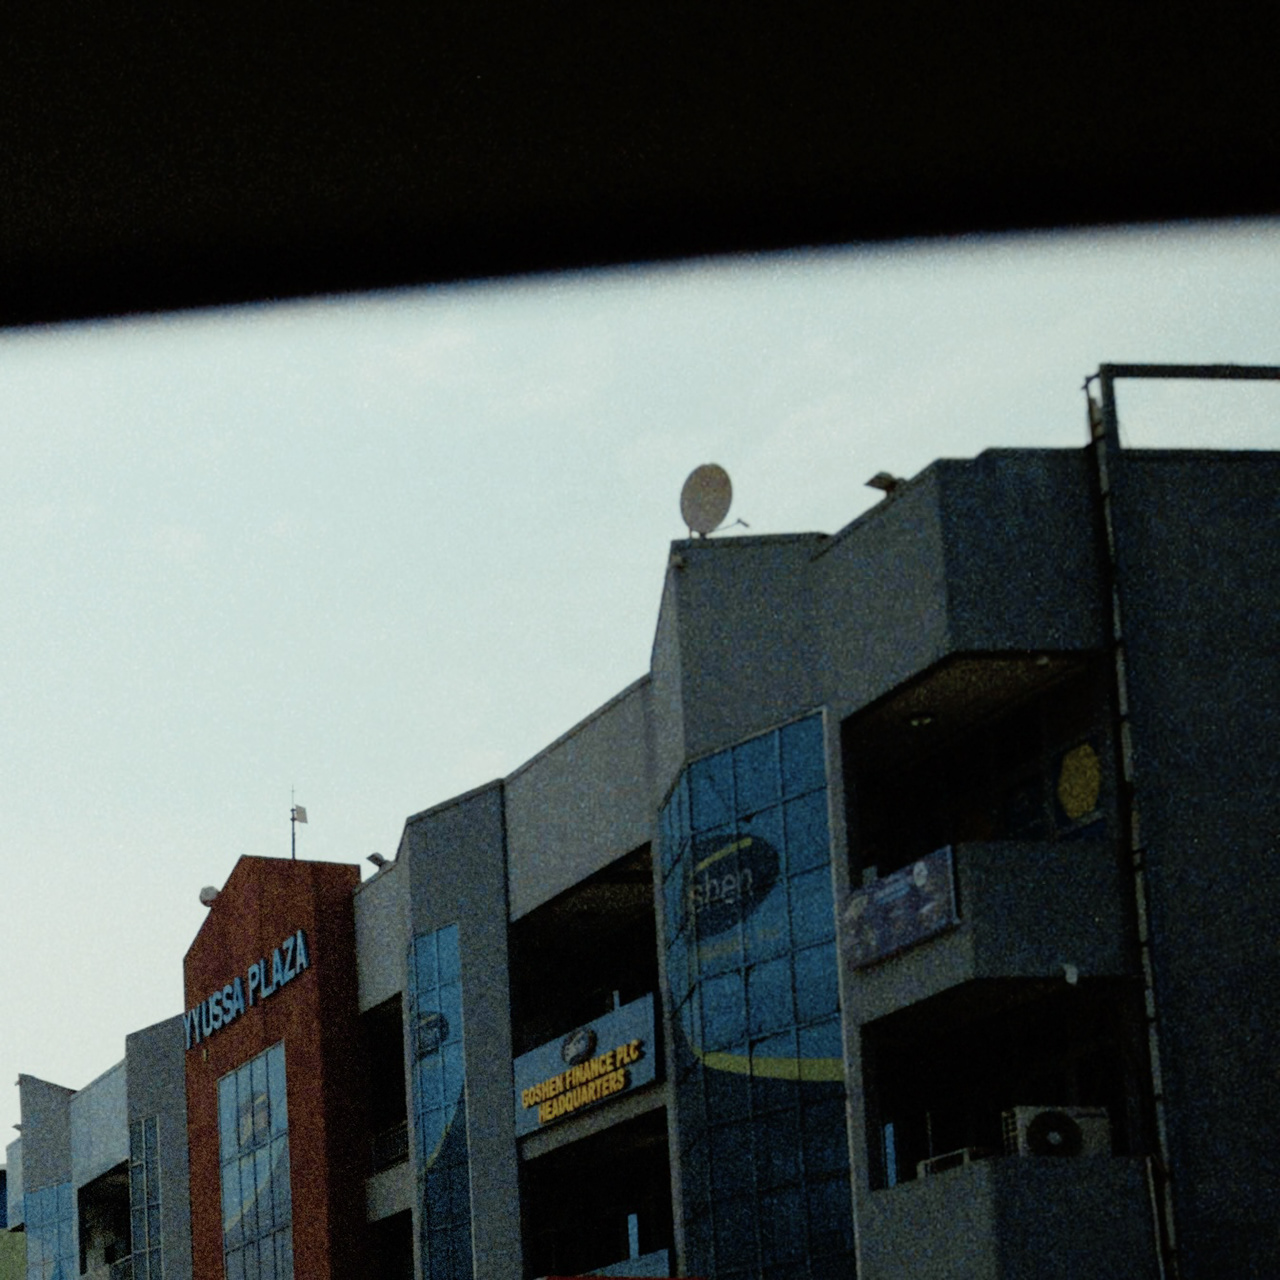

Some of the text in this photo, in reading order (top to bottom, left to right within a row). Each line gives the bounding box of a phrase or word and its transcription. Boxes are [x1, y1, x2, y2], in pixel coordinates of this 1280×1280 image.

[248, 929, 310, 1006] PLAZA
[521, 1038, 641, 1109] GOSHEN FINANCE PLC
[538, 1068, 626, 1124] HEADQUARTERS
